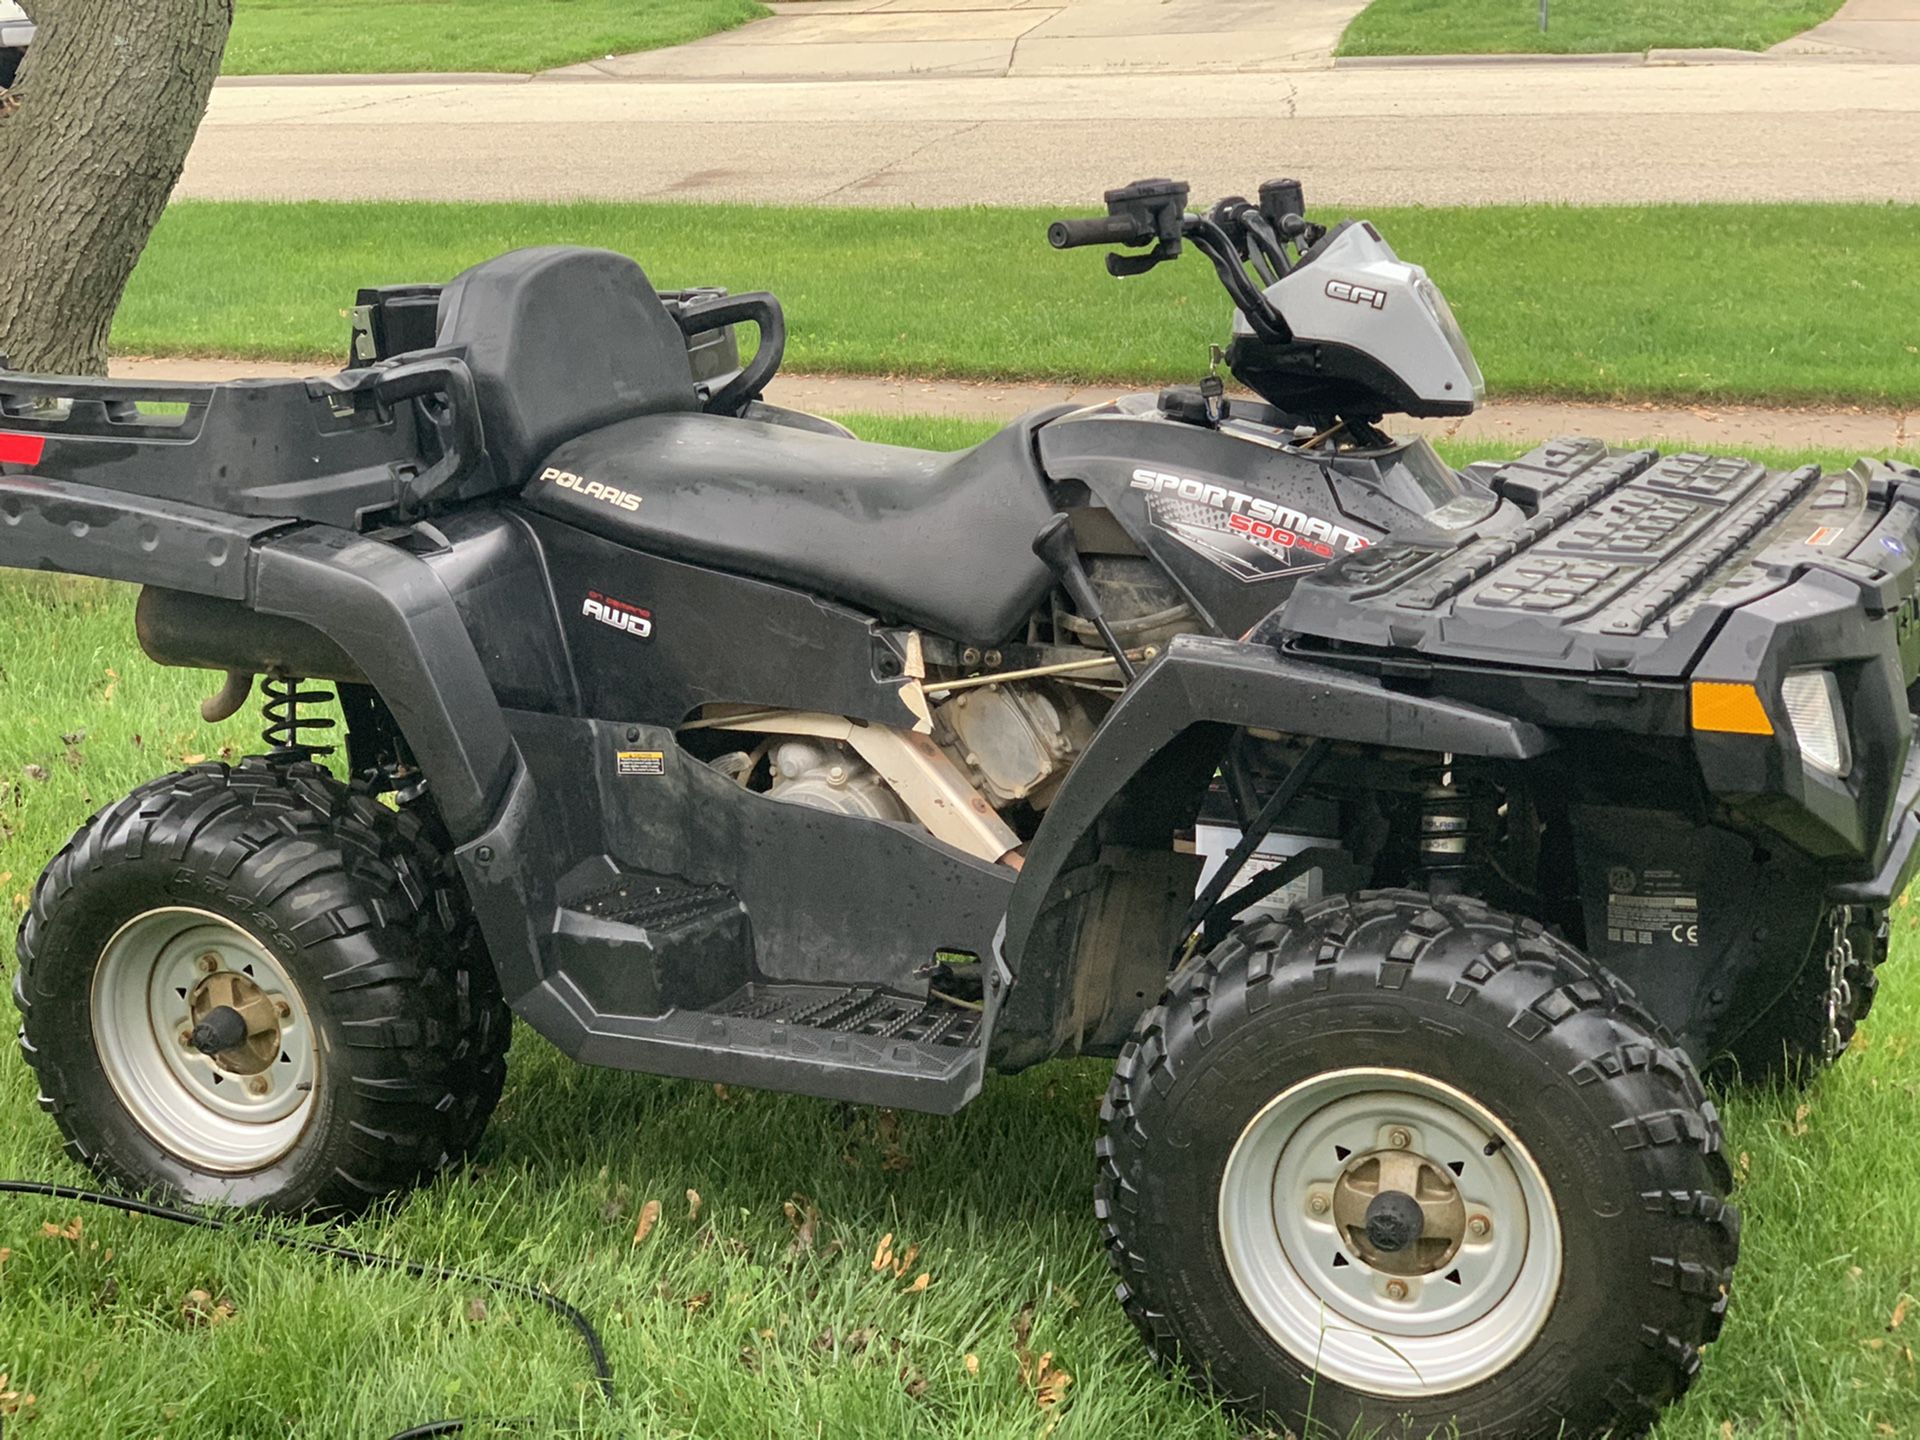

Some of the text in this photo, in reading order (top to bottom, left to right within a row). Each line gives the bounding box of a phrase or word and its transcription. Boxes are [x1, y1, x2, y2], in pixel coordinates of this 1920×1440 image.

[1325, 280, 1387, 310] EFI
[539, 467, 643, 512] POLARIS
[1228, 512, 1297, 549] 500
[582, 598, 652, 638] AWD
